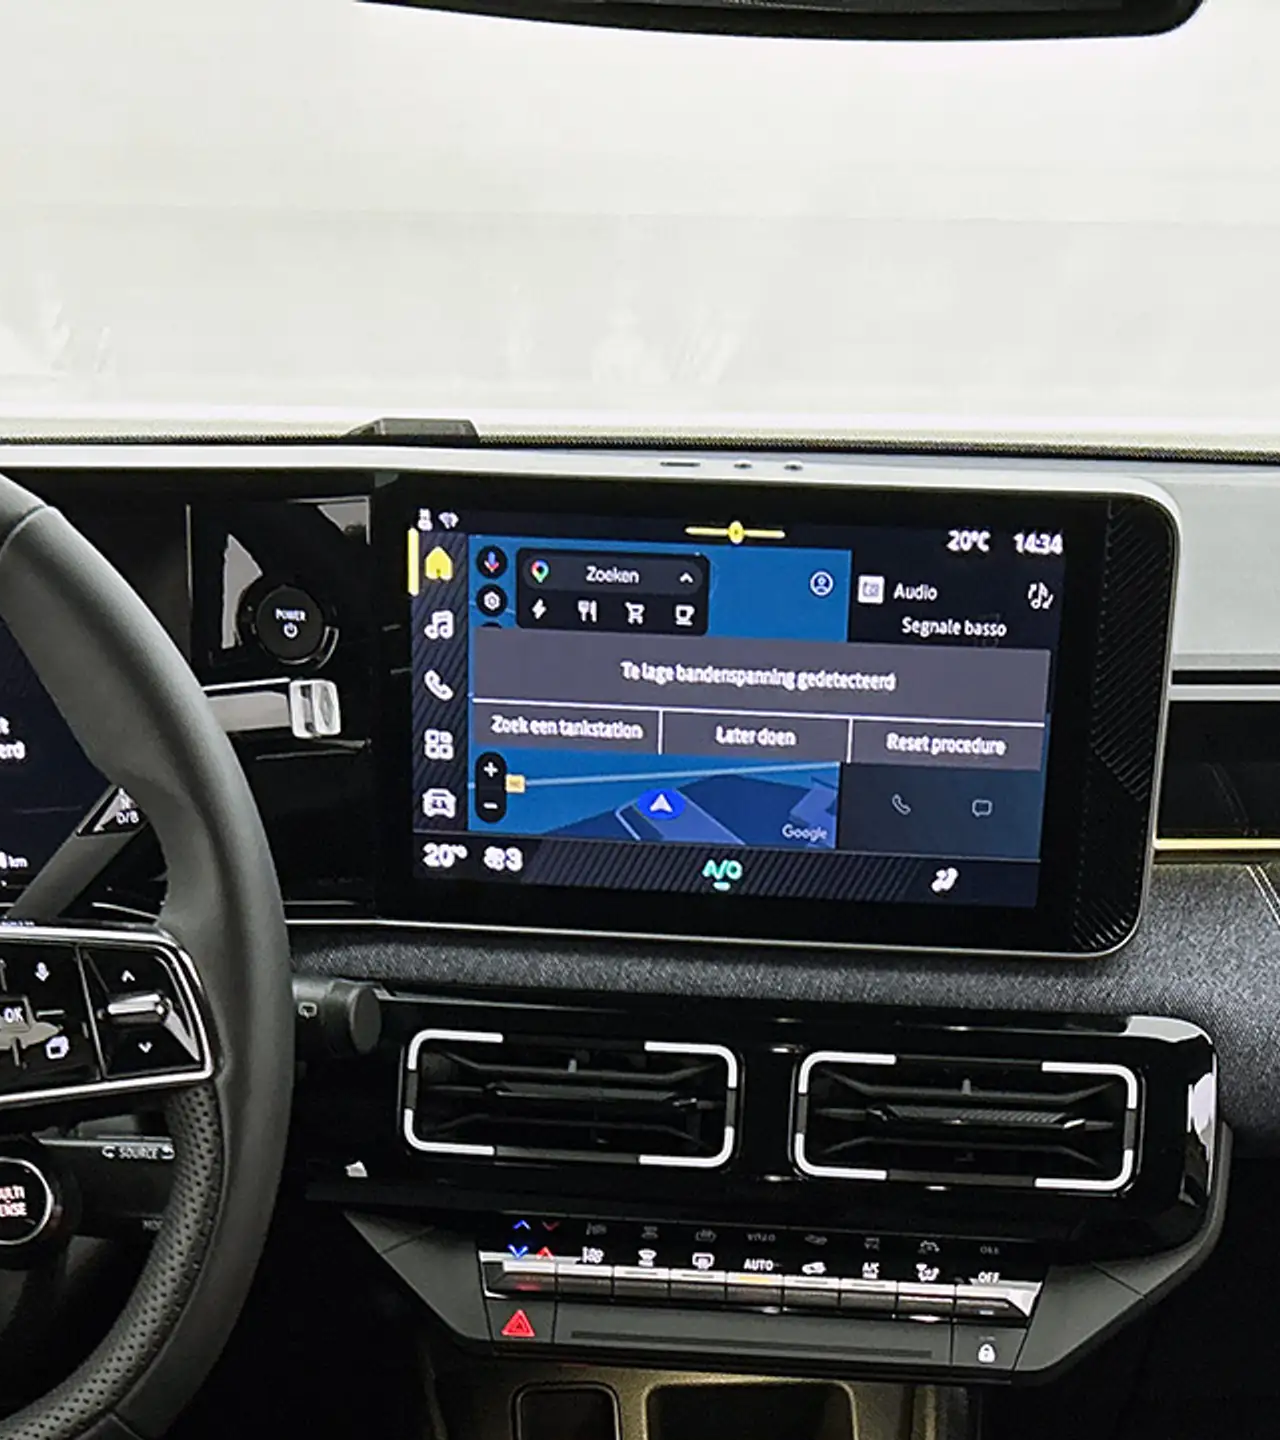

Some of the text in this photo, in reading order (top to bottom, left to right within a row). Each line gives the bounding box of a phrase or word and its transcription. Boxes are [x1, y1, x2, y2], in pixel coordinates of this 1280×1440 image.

[586, 565, 639, 583] Zoeken
[893, 583, 938, 601] Audio
[901, 616, 1008, 638] Segnale basso
[620, 661, 897, 692] Te lage bandenspanning gedetecteerd
[491, 715, 643, 740] Zoek een tankstation
[716, 726, 796, 747] Later doen
[887, 732, 1007, 757] Reset procedure
[782, 824, 827, 842] Google
[3, 1006, 23, 1023] OK
[119, 1147, 159, 1160] SOURCE
[743, 1258, 774, 1271] AUTO
